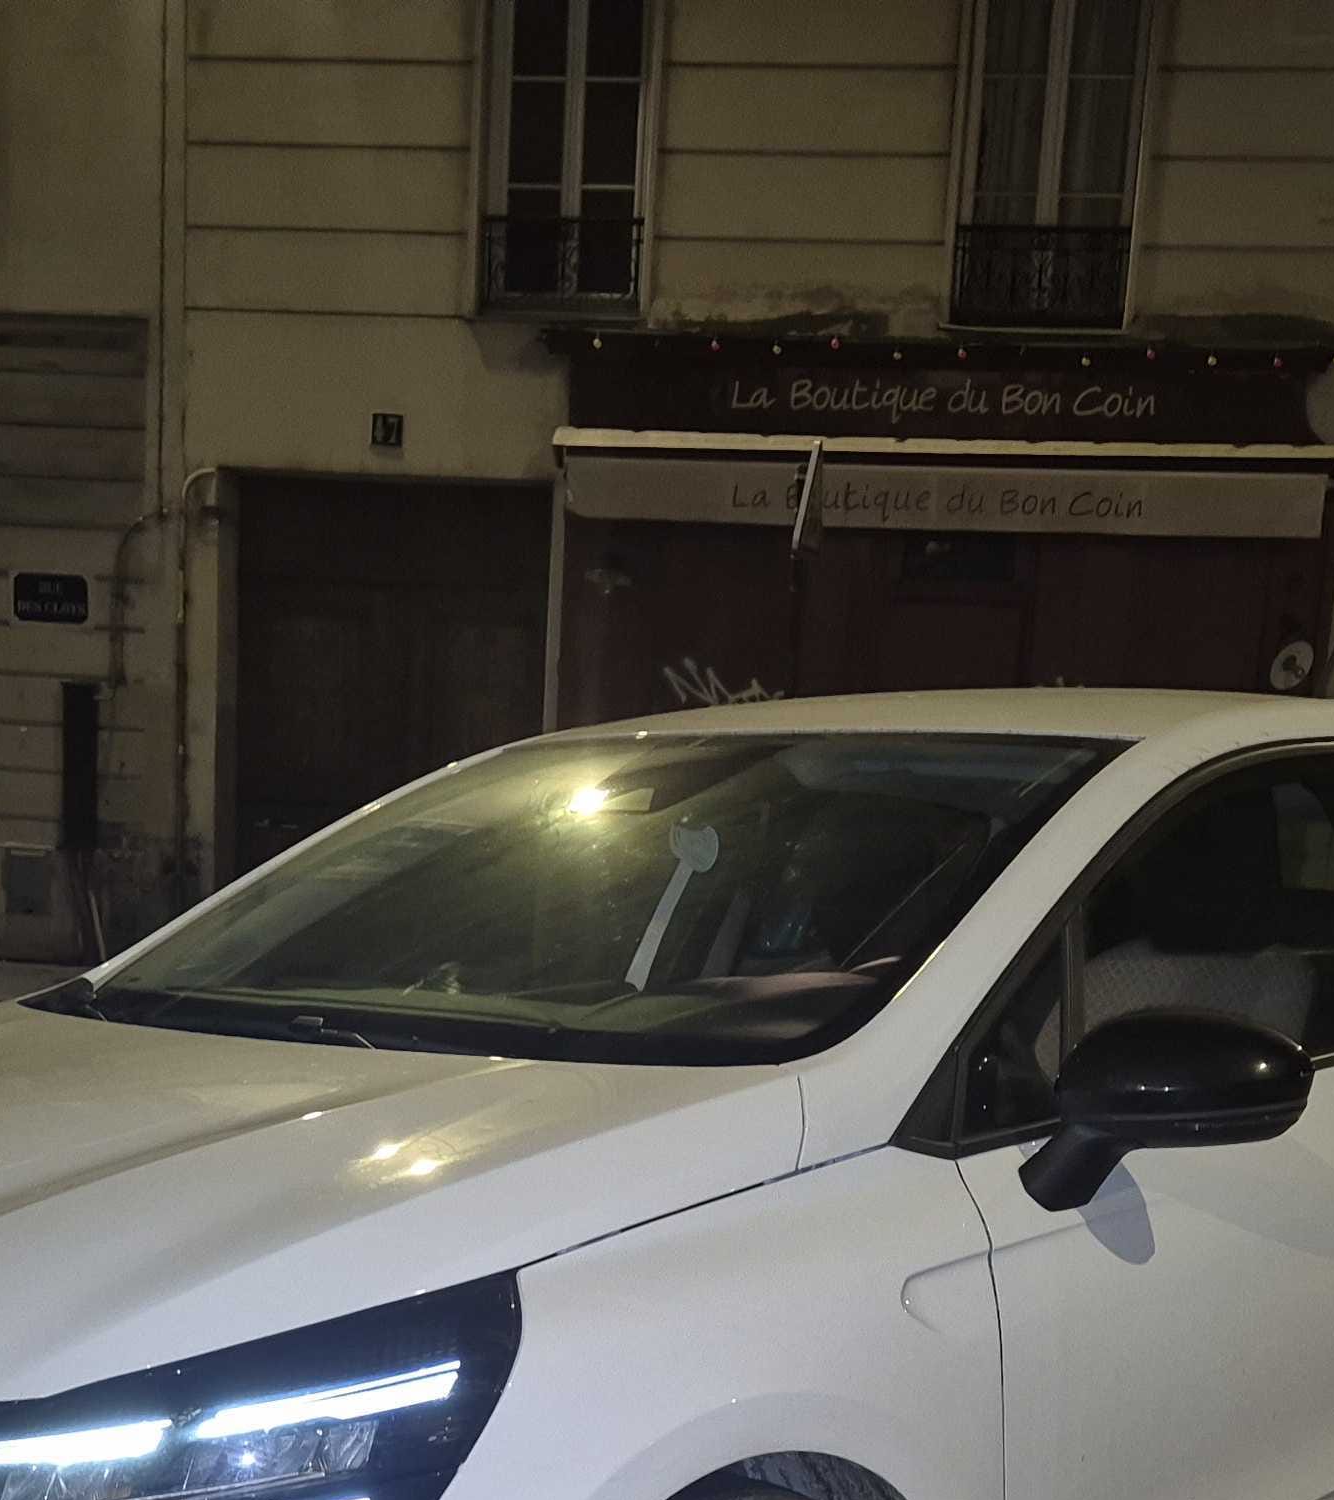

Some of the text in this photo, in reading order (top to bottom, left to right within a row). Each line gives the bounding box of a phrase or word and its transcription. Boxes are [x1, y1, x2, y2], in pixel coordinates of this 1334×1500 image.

[731, 377, 1156, 424] La Boutique du Bon Coin
[731, 481, 1144, 523] La Butique du Bon Coin
